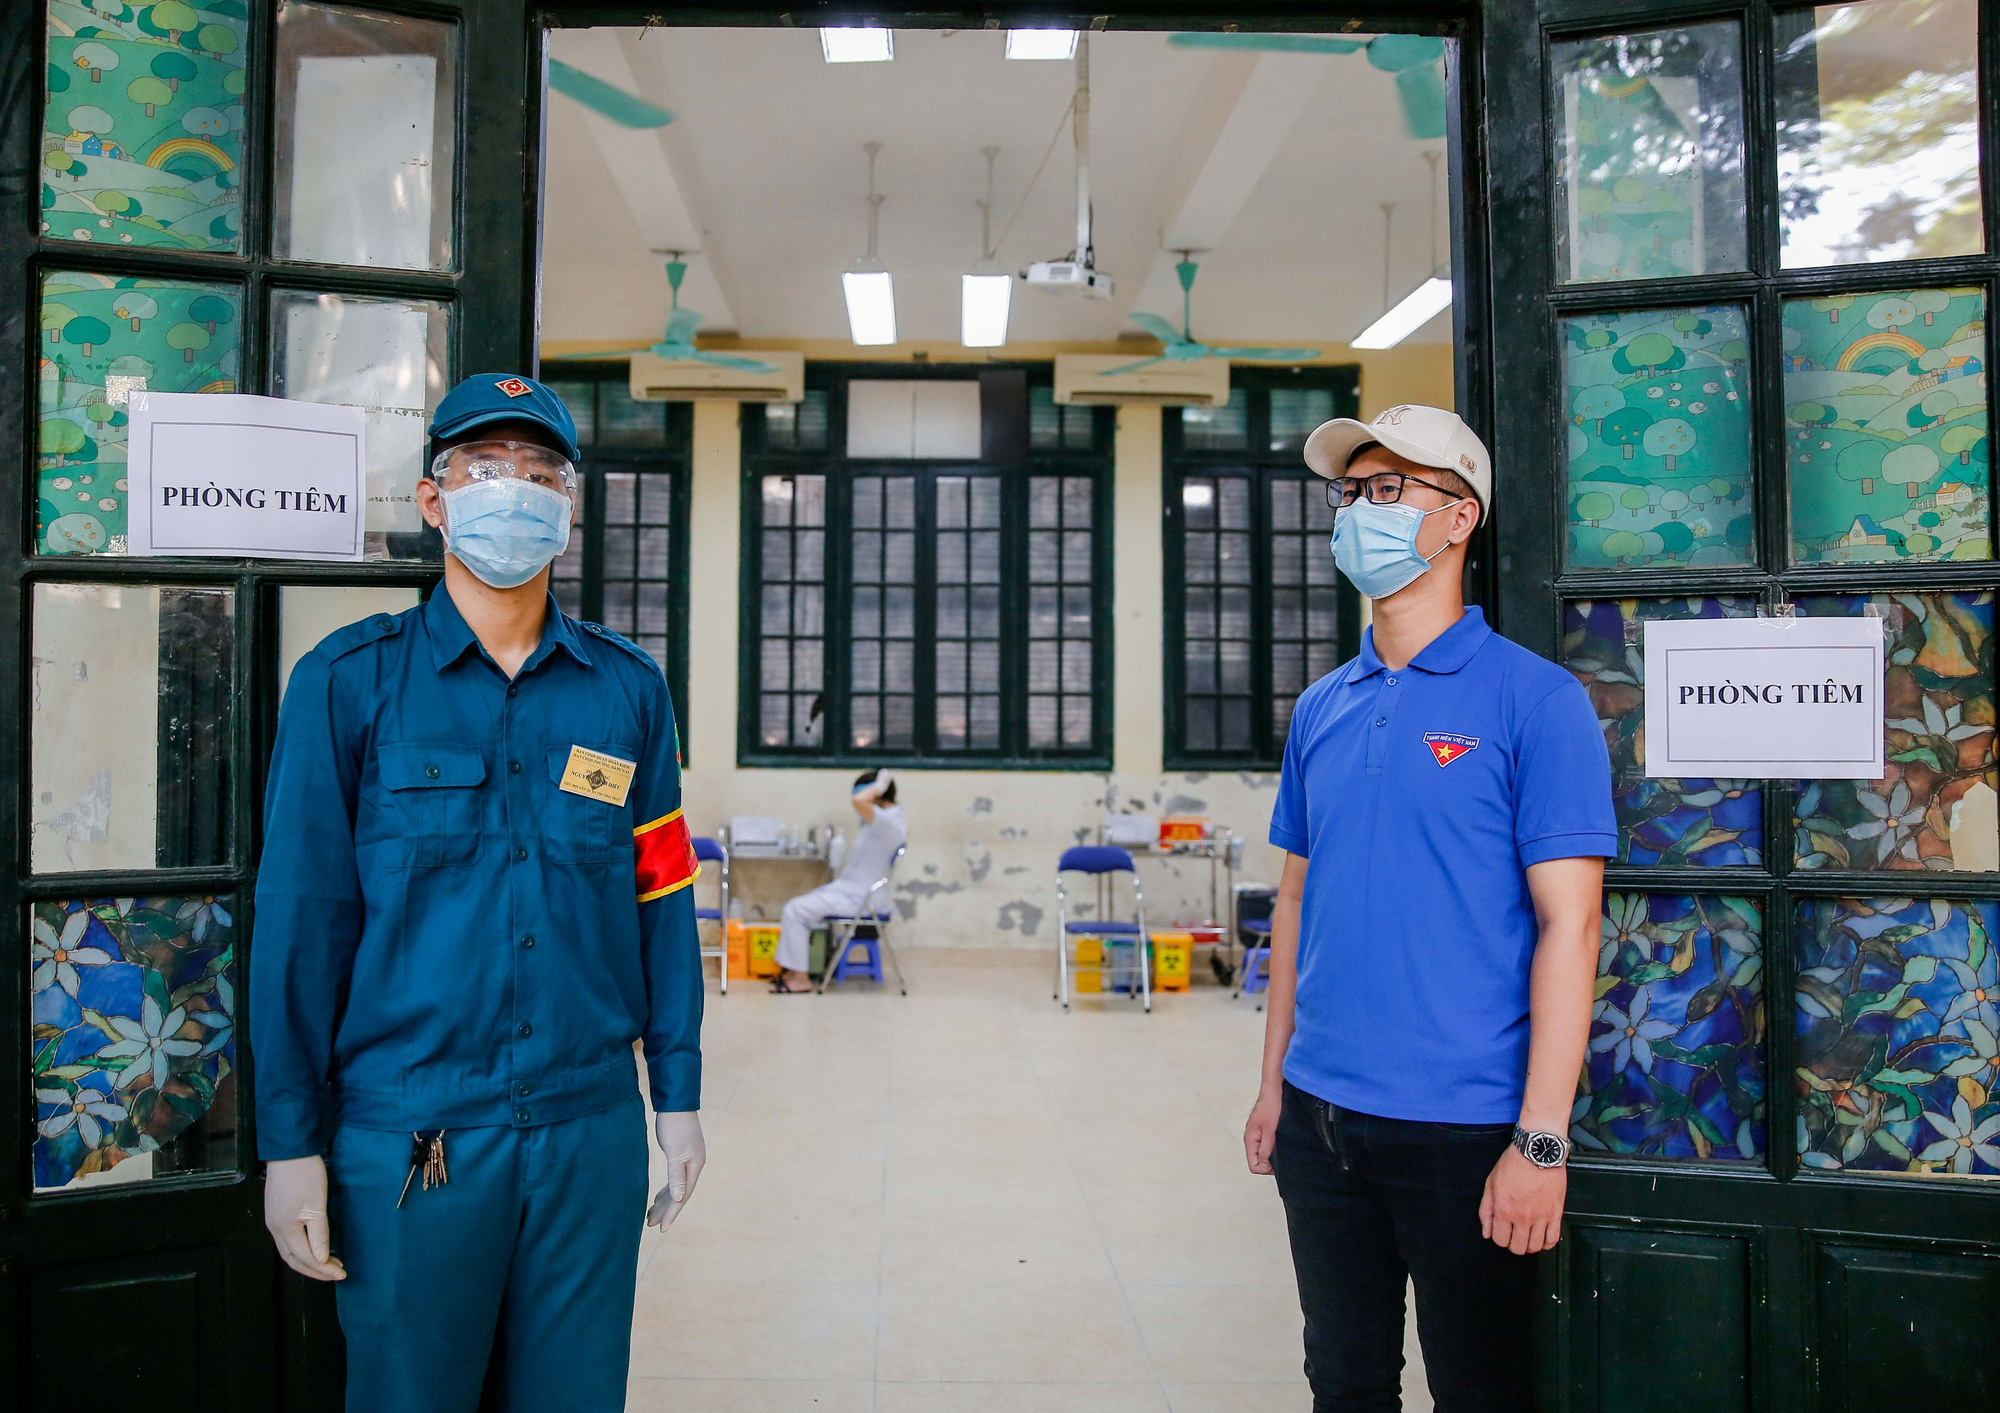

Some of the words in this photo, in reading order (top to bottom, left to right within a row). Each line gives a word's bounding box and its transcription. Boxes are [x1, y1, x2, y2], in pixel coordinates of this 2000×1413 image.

[161, 482, 266, 509] PHÒNG
[274, 487, 347, 514] TIÊM
[1678, 679, 1783, 705] PHÒNG
[1792, 678, 1864, 704] TIÊM
